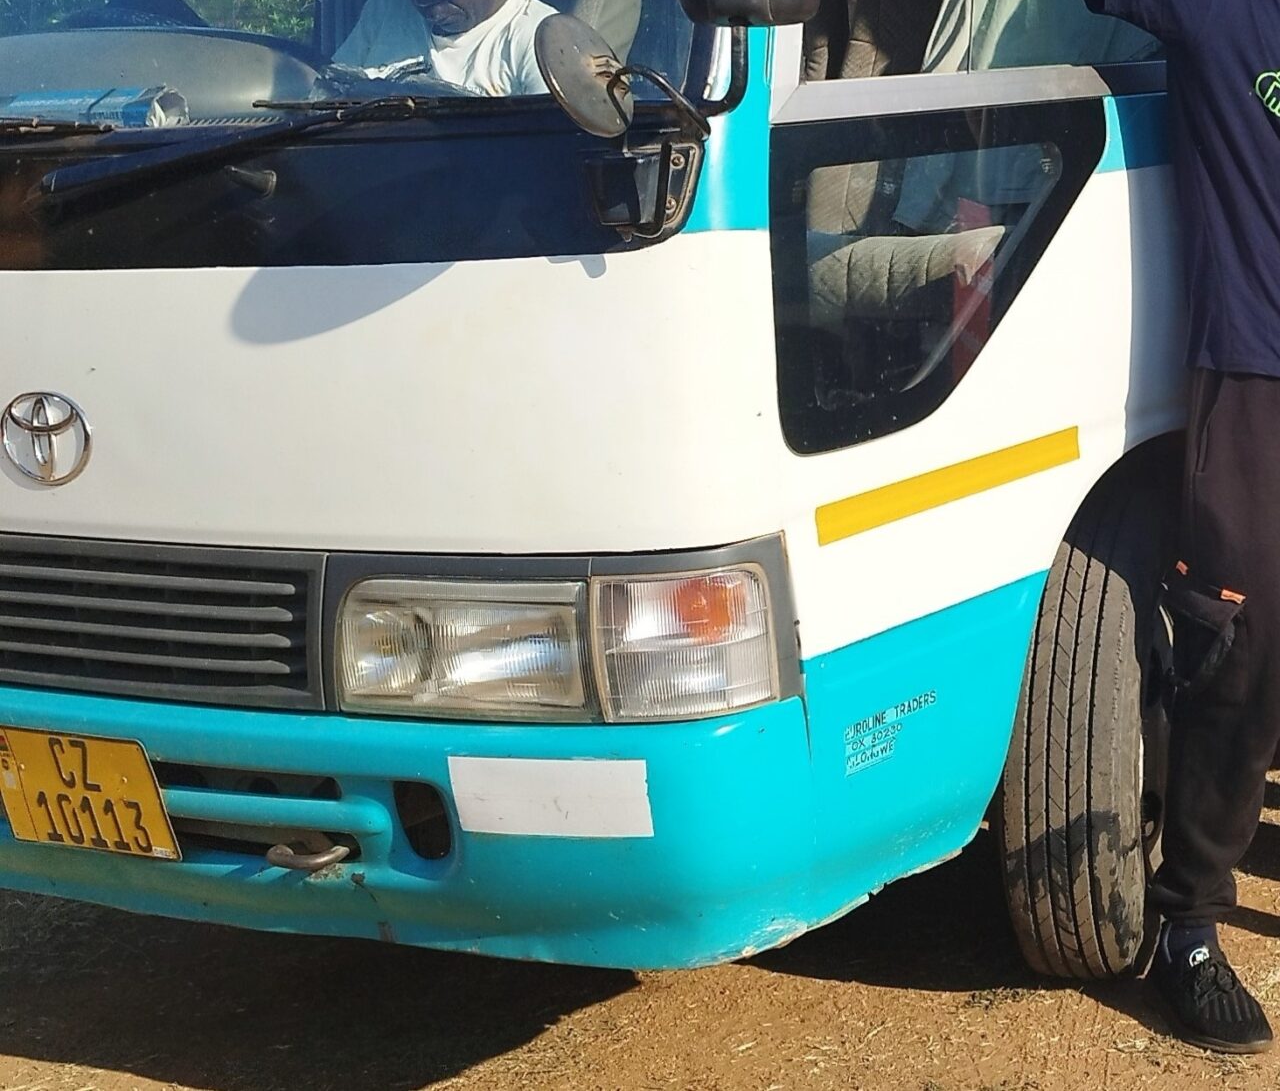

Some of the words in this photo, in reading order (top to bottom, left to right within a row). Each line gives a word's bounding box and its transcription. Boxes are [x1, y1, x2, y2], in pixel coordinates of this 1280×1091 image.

[894, 690, 937, 719] TRADERS
[48, 737, 103, 793] CZ
[36, 791, 153, 853] 10113
